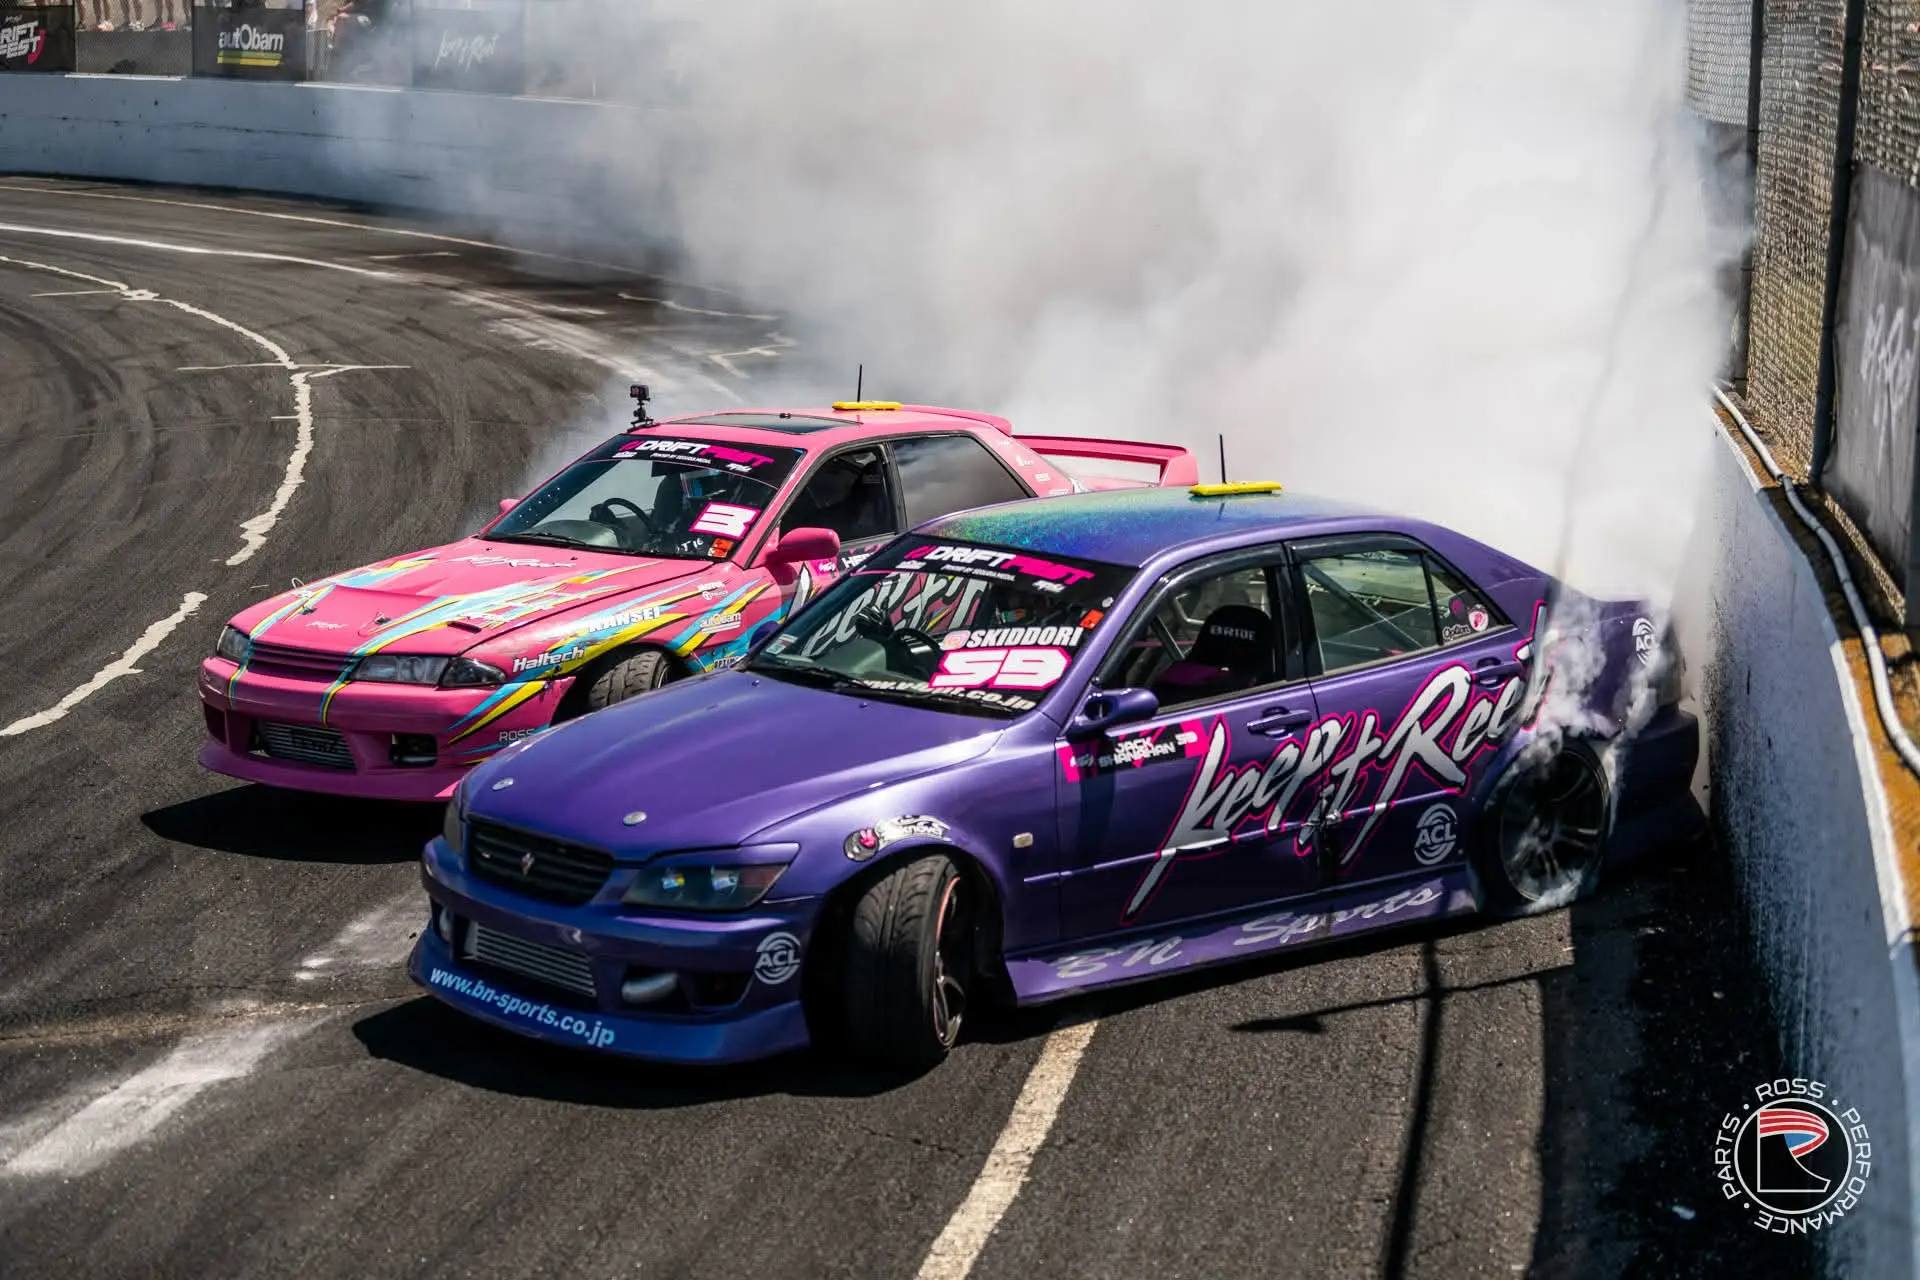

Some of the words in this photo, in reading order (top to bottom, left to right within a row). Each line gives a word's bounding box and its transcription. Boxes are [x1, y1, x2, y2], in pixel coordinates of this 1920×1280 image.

[692, 502, 758, 539] 3
[968, 627, 1084, 648] SKIDDORI
[1210, 625, 1256, 641] BRIDE
[513, 646, 585, 673] Haltech
[930, 647, 1071, 689] 59
[1234, 879, 1443, 946] Sports
[755, 949, 801, 969] ACL
[430, 967, 615, 1048] www.bn-sports.co.jp
